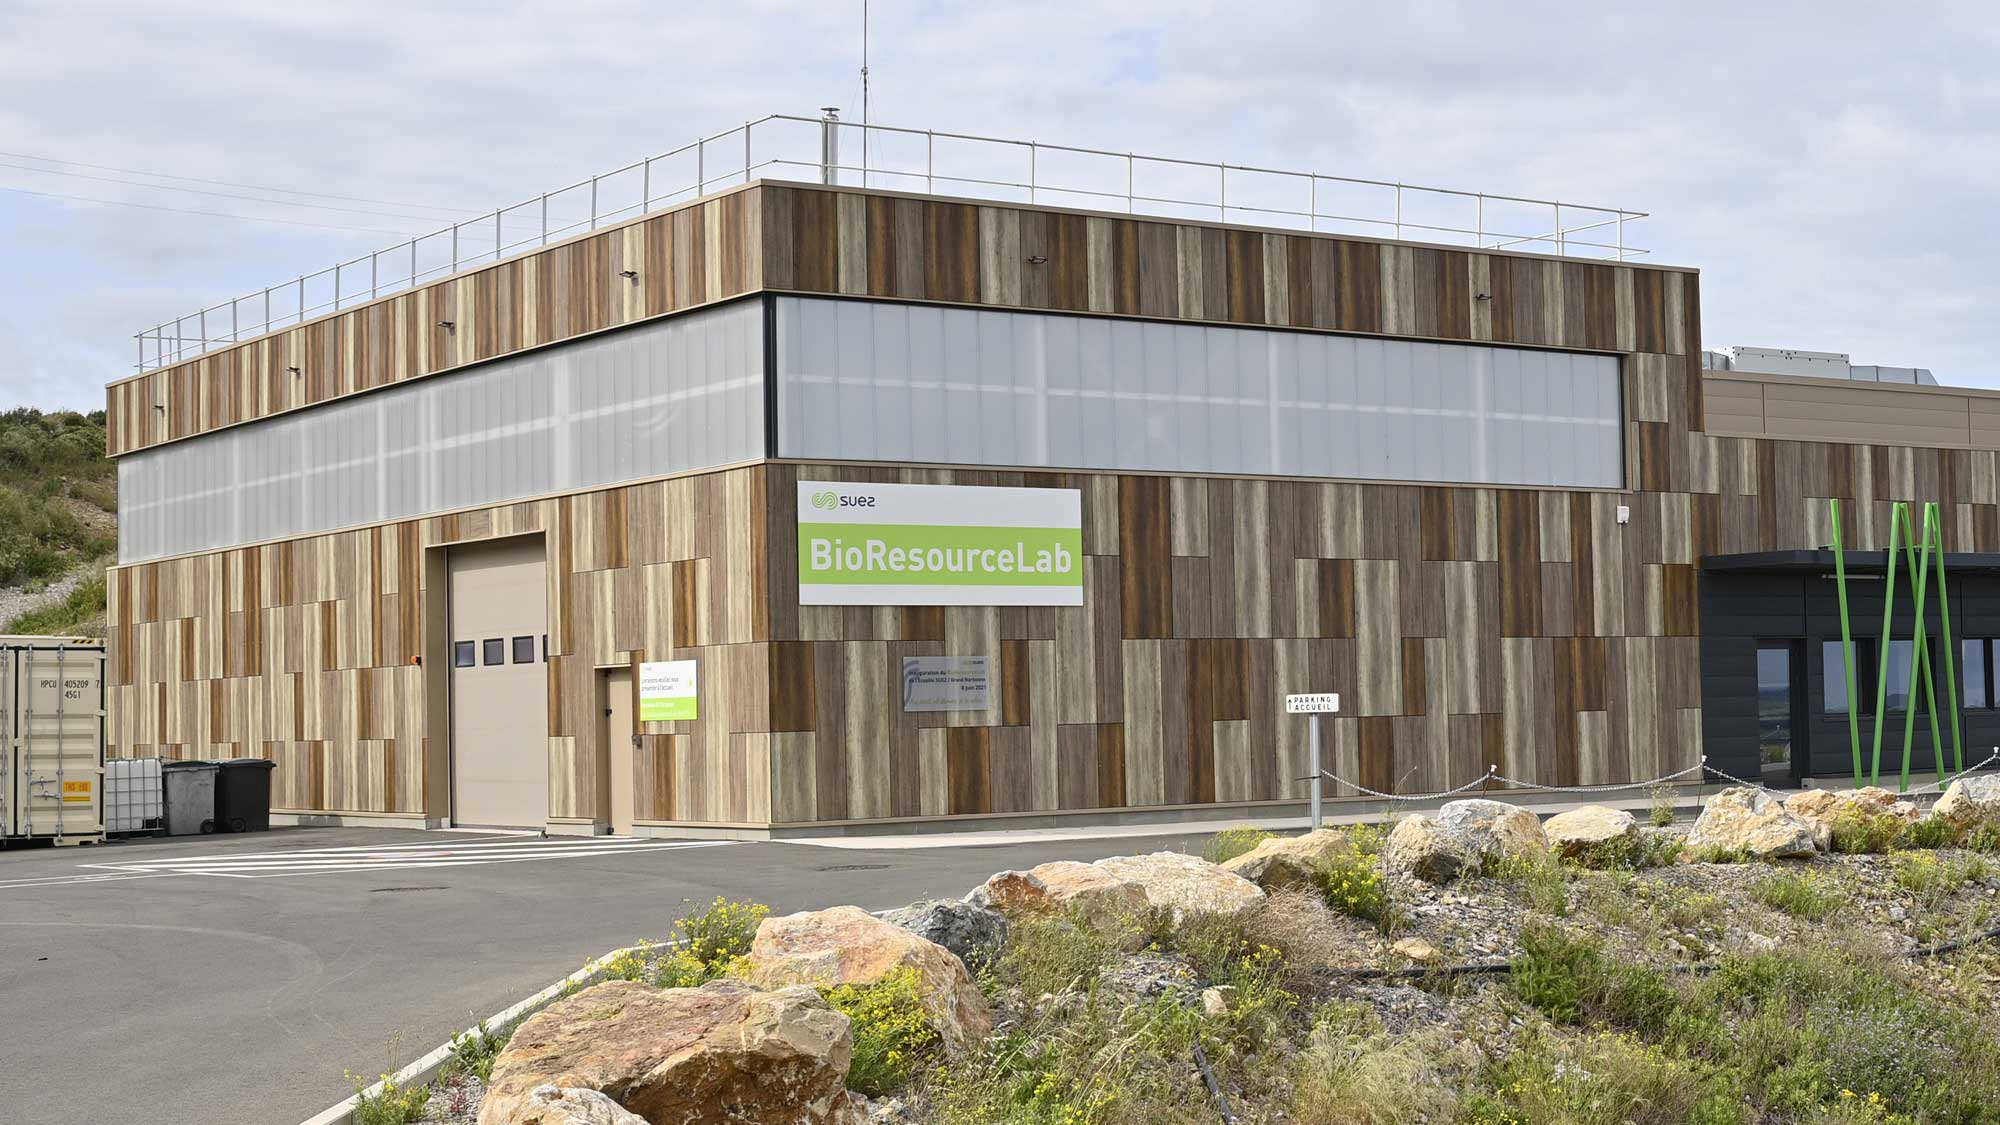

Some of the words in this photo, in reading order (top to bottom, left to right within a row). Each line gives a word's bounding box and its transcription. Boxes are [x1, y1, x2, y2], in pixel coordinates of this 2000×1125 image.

[810, 538, 1072, 574] BioResourceLab
[40, 680, 57, 688] HPCU
[64, 680, 89, 688] 405209
[96, 680, 101, 688] 7
